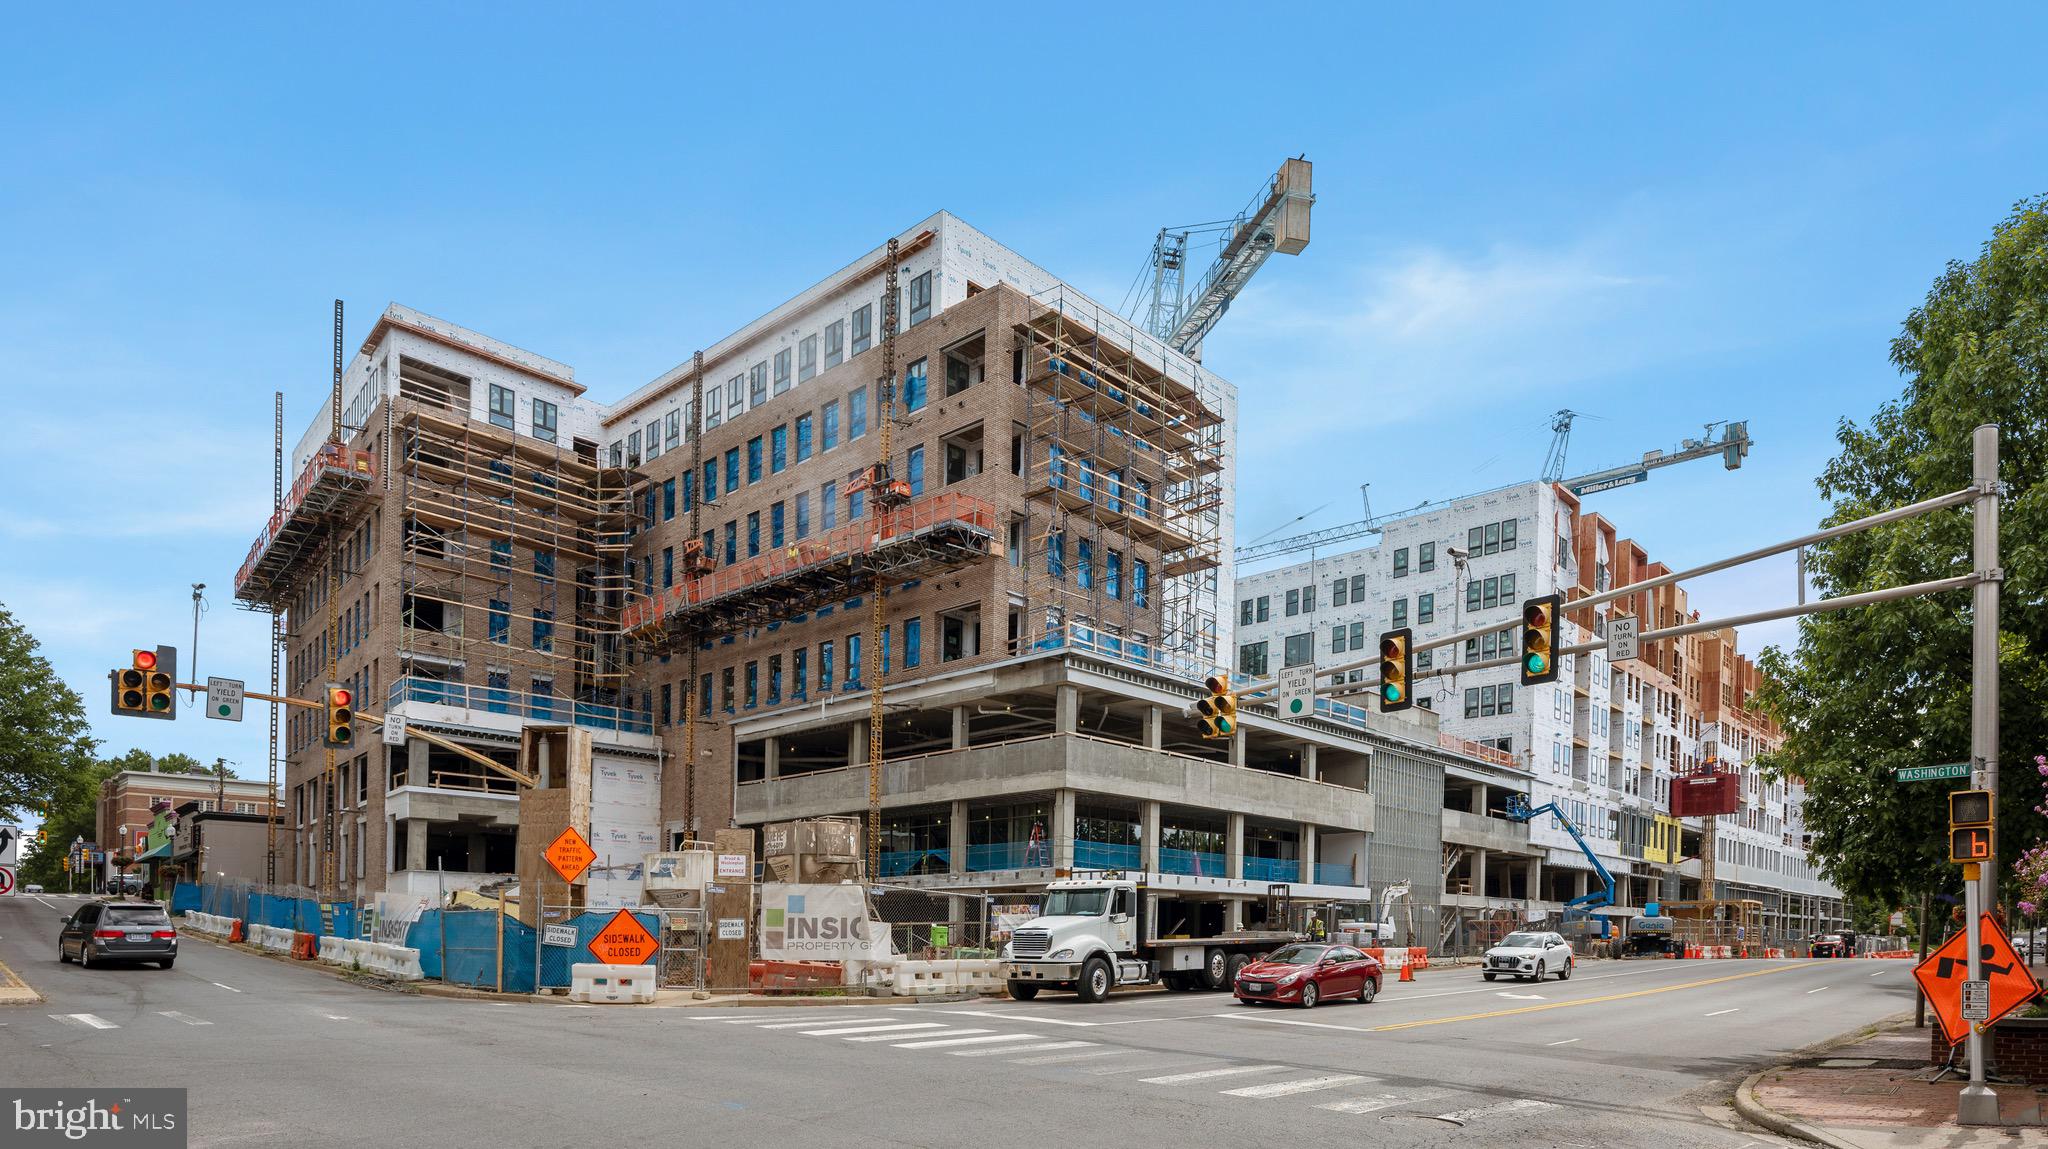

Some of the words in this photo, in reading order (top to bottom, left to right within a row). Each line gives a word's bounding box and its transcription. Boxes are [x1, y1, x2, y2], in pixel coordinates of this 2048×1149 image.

[1615, 622, 1630, 632] NO
[1613, 632, 1633, 640] TURN
[1617, 641, 1628, 649] ON
[1616, 649, 1630, 657] RED
[1281, 671, 1294, 680] LEFT
[1299, 667, 1313, 675] TURN
[1288, 677, 1307, 689] YIELD
[216, 688, 236, 697] YIELD
[1295, 687, 1311, 696] GREEN
[390, 716, 401, 724] NO
[601, 769, 617, 778] Tyvek
[627, 772, 644, 780] Tyvek
[1898, 765, 1967, 780] WASHINGTON
[611, 832, 627, 840] Tyvek
[1639, 921, 1665, 929] Genie
[547, 927, 575, 935] SIDEWALK
[549, 935, 572, 943] CLOSED
[604, 934, 645, 944] SIDEWALK
[787, 941, 856, 951] PROPERTY
[608, 947, 641, 957] CLOSED
